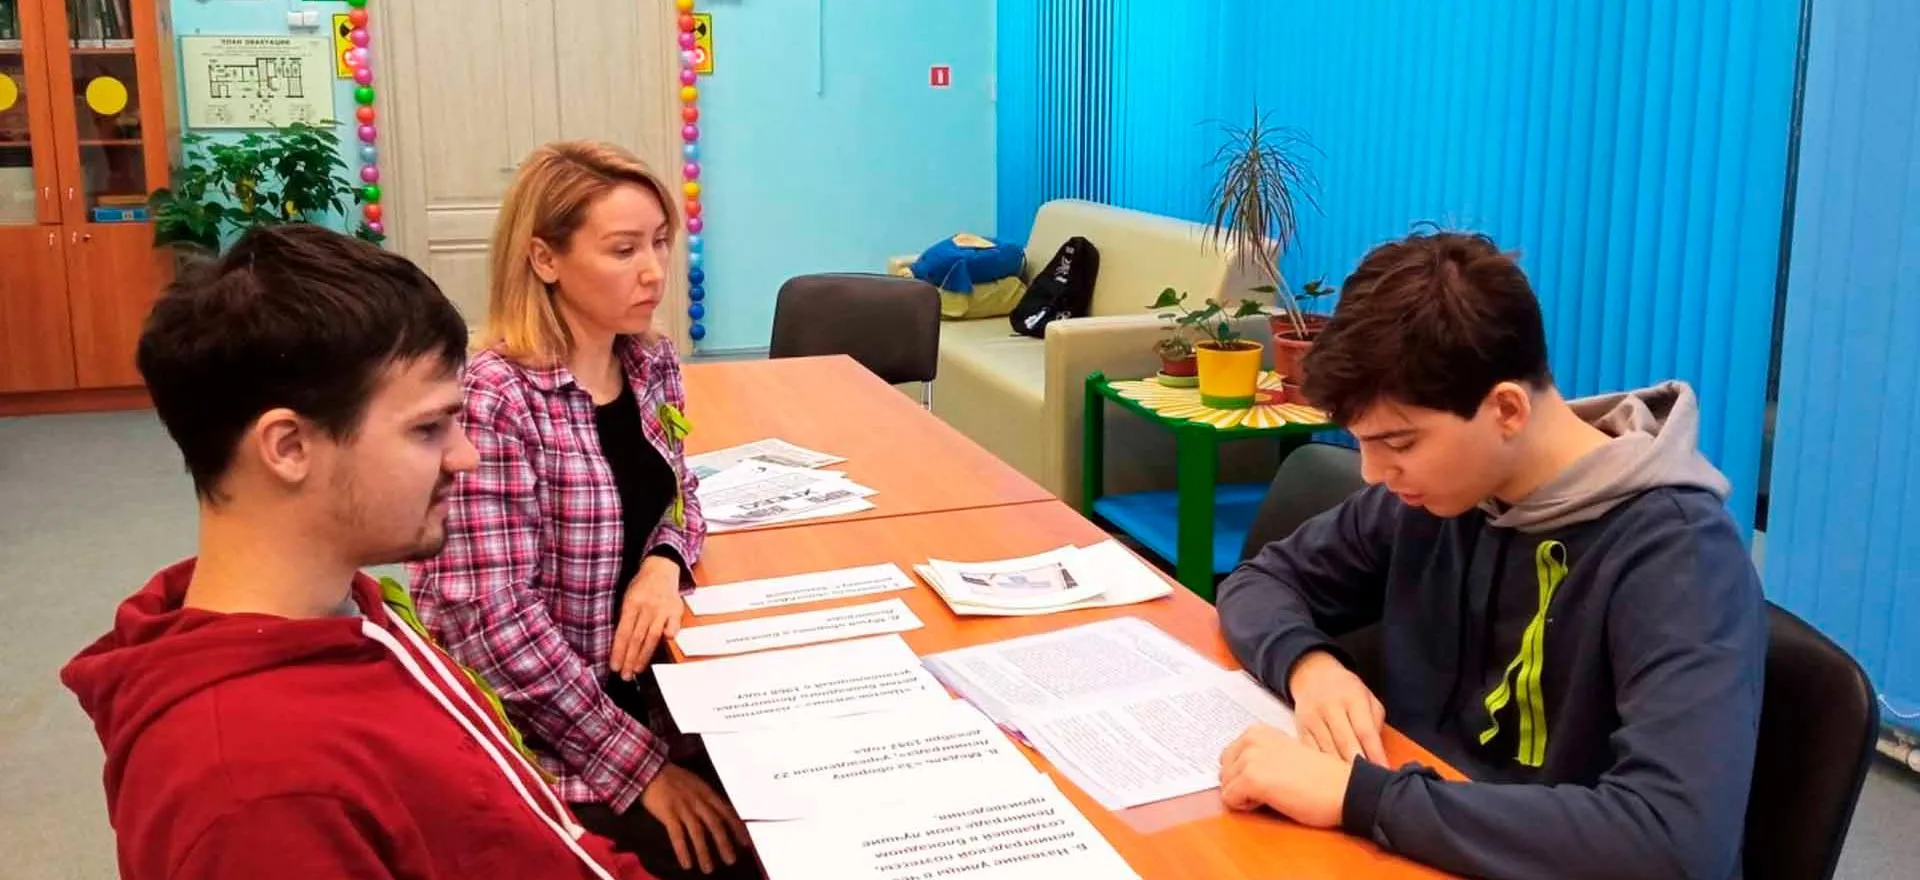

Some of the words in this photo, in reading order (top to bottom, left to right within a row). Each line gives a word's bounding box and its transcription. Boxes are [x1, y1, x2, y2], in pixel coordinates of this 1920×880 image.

[773, 771, 790, 780] 22
[965, 807, 1056, 830] Ленинграде
[924, 825, 962, 837] свои
[981, 819, 1066, 842] создавшей
[861, 832, 921, 849] лучшие
[956, 830, 1076, 860] ленинградской
[874, 854, 955, 873] поэтессы,
[993, 848, 1070, 867] Название
[937, 860, 991, 877] улицы
